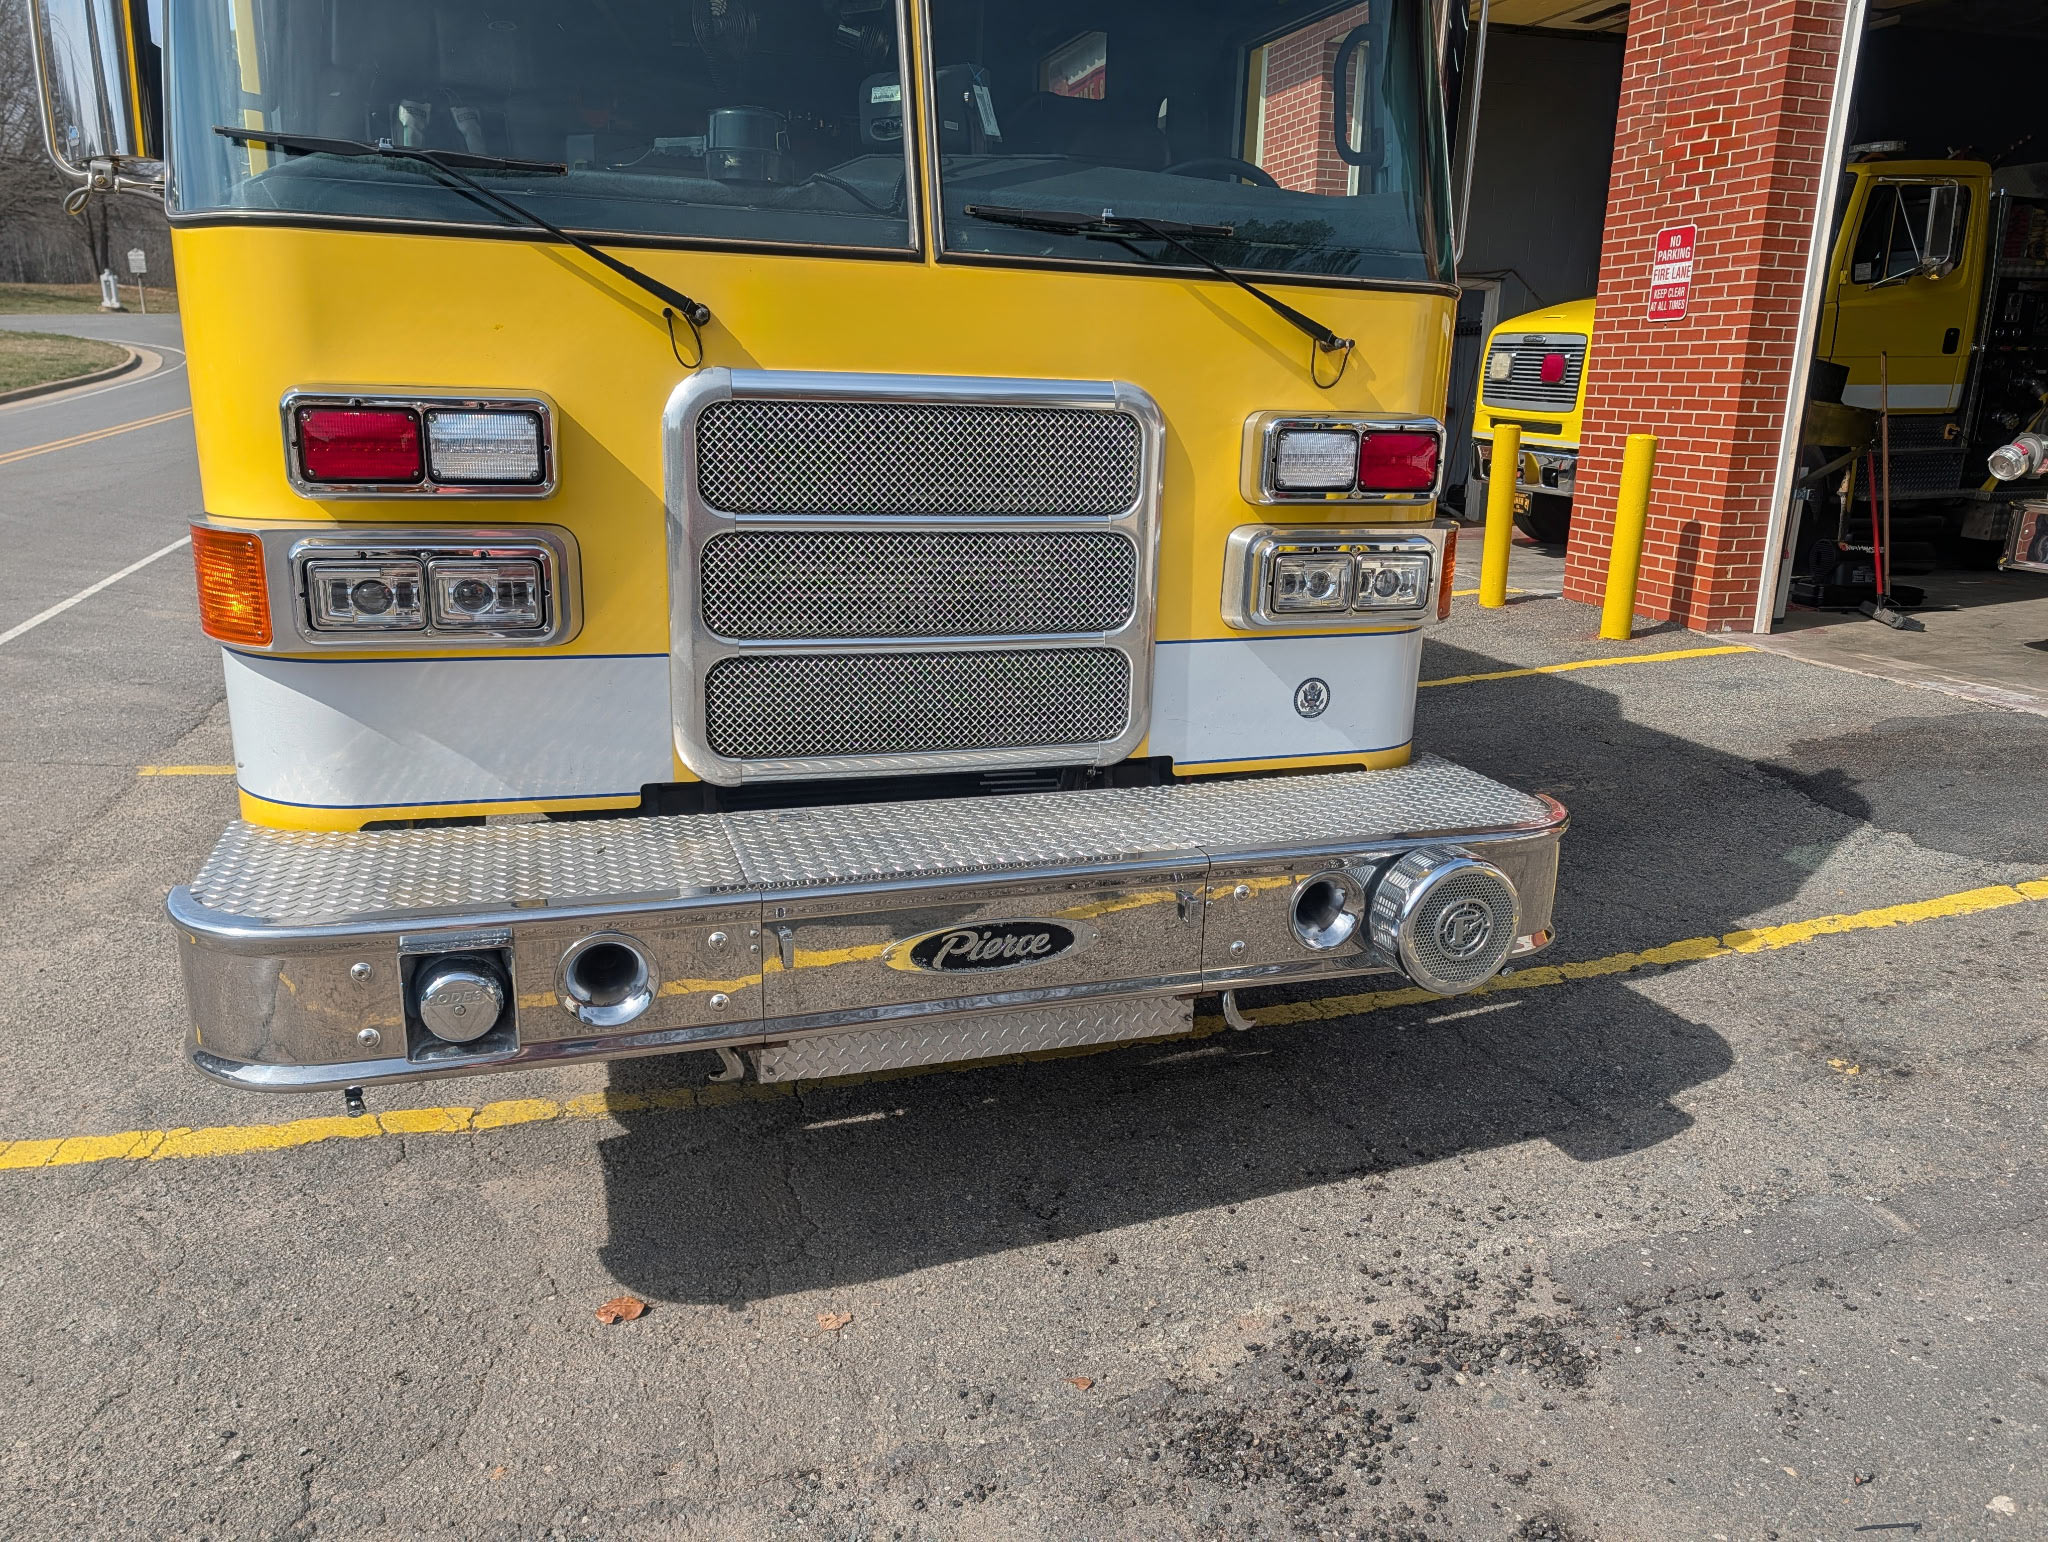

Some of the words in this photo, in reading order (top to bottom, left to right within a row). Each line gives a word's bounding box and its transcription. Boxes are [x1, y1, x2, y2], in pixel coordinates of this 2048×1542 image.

[1670, 235, 1681, 247] NO
[1658, 247, 1691, 262] PARKING
[1653, 268, 1670, 281] FIRE
[1671, 265, 1691, 279] LANE
[1654, 289, 1667, 299] KEEP
[1668, 287, 1685, 298] CLEAR
[1650, 302, 1657, 311] AT
[1657, 301, 1667, 311] ALL
[1668, 299, 1685, 311] TIMES
[932, 930, 1052, 970] Pierce
